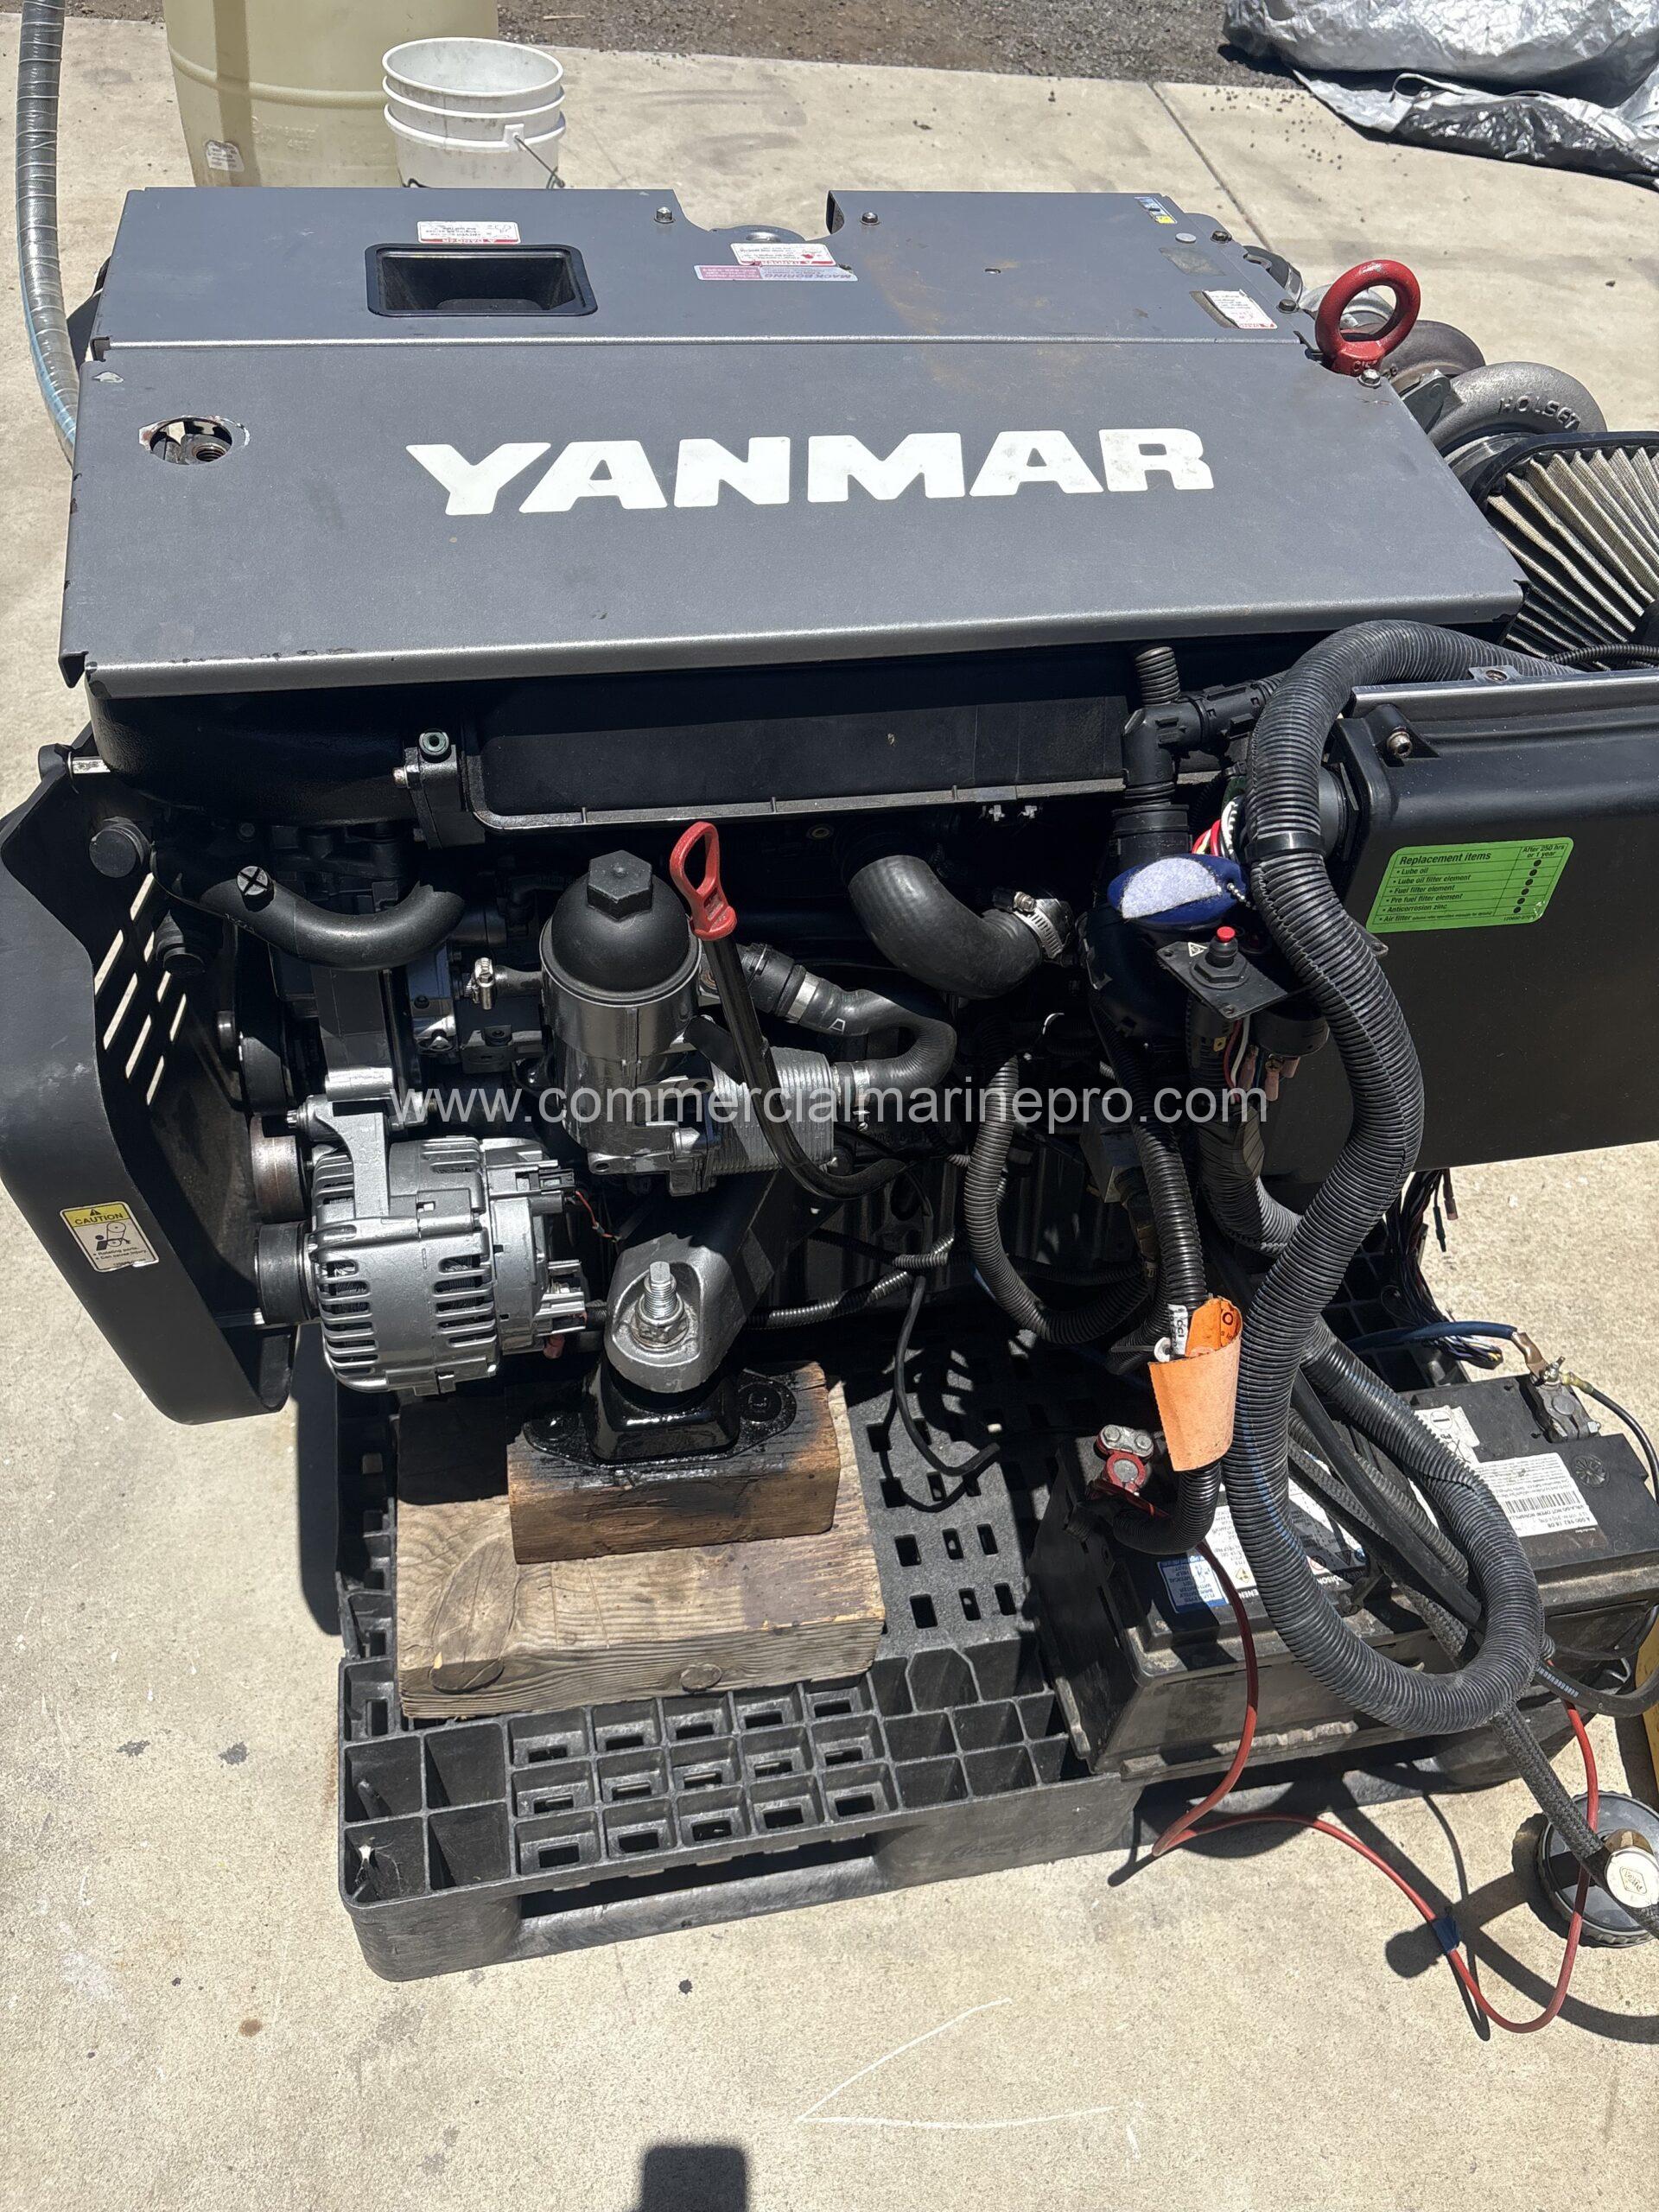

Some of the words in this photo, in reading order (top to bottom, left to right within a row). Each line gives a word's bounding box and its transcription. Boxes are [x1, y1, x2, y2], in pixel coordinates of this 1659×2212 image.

[1498, 395, 1580, 430] HOLSET
[406, 429, 1214, 516] YANMAR
[1400, 854, 1463, 865] Replacement
[1465, 852, 1491, 861] items
[75, 1213, 124, 1224] CAUTION
[1236, 1588, 1260, 1599] ENEN
